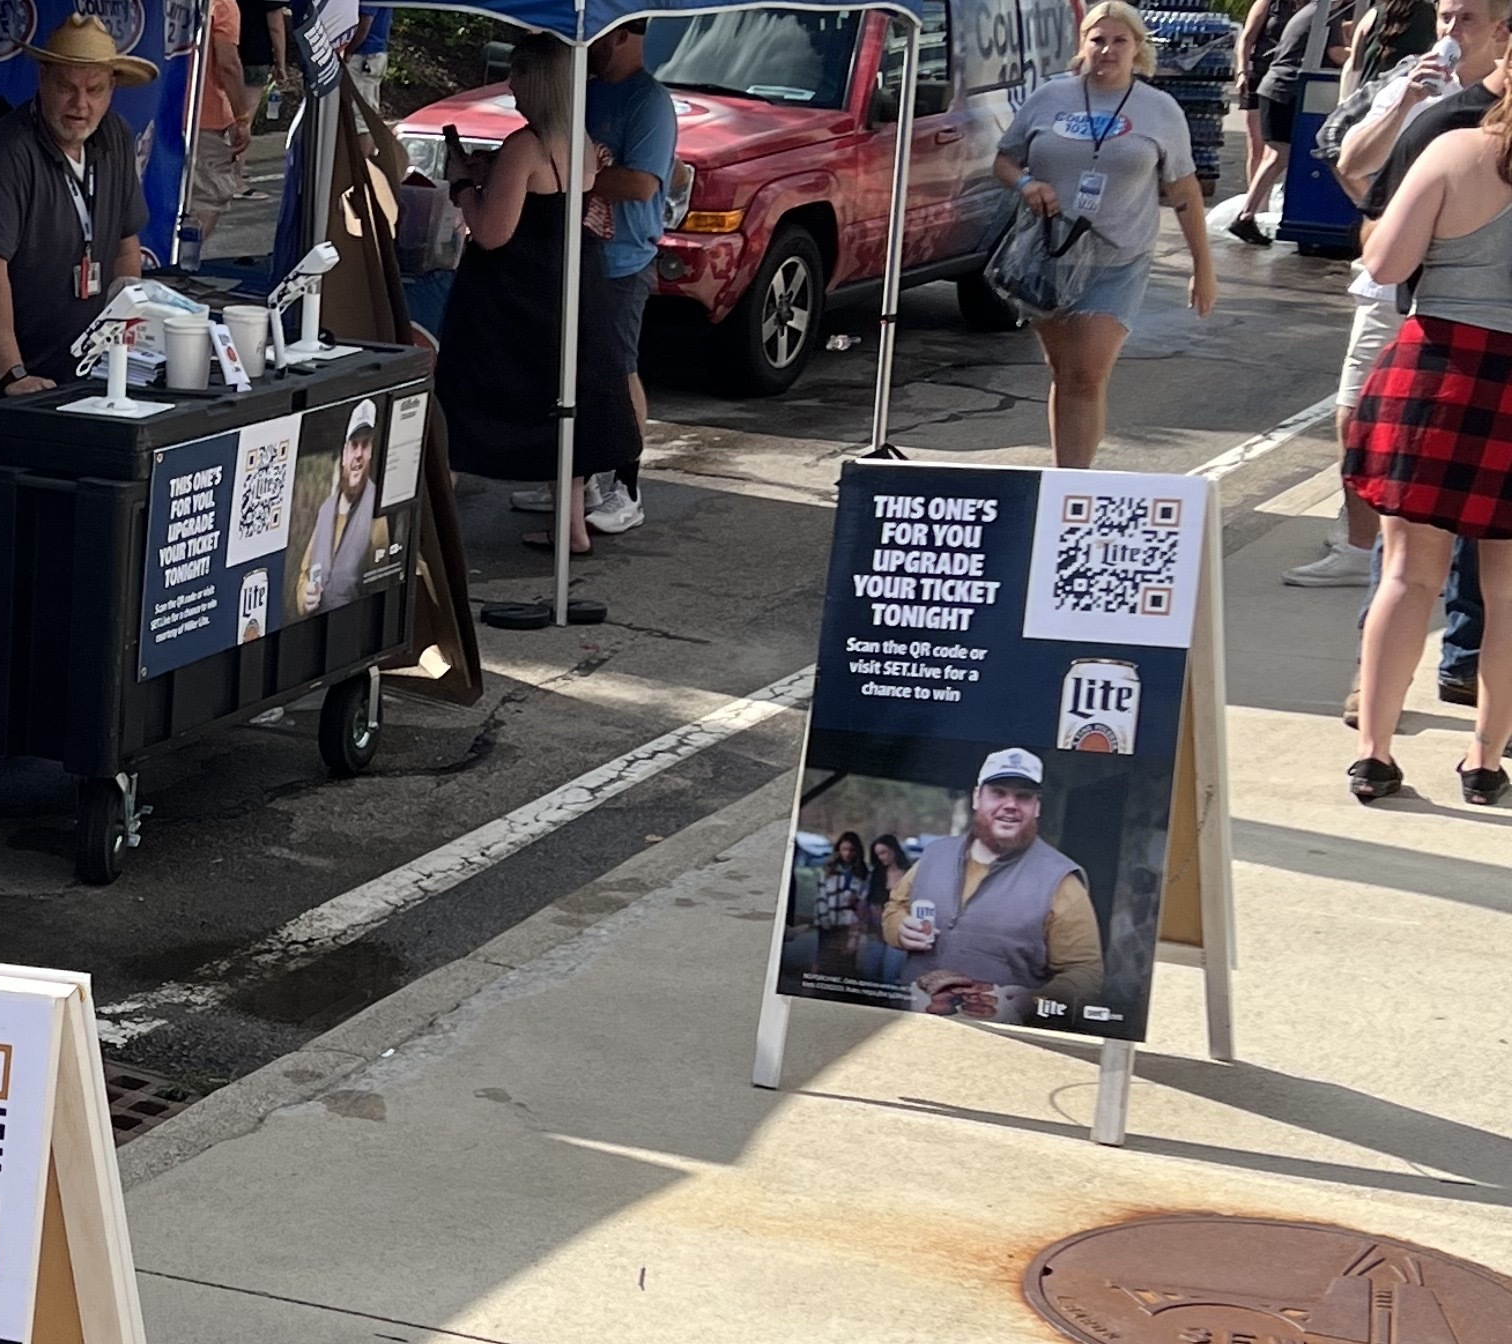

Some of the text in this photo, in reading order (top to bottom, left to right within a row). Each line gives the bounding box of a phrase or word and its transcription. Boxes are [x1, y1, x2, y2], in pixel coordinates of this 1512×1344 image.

[169, 465, 223, 498] THIS ONE'S
[170, 497, 192, 520] FOR
[873, 494, 998, 522] THIS ONE'S
[168, 511, 215, 543] UPGRADE
[880, 522, 984, 548] FOR YOU
[159, 530, 220, 568] YOUR TICKET
[872, 549, 986, 577] UPGRADE
[1101, 542, 1141, 566] Lite
[164, 555, 211, 589] TONIGHT!
[243, 585, 266, 618] Lite
[852, 574, 1002, 605] YOUR TICKET
[871, 602, 976, 631] TONIGHT
[846, 637, 989, 660] Scan the QR code or
[849, 658, 980, 682] visit SET.Live for a
[861, 681, 962, 702] chance to win
[1068, 676, 1133, 719] Lite
